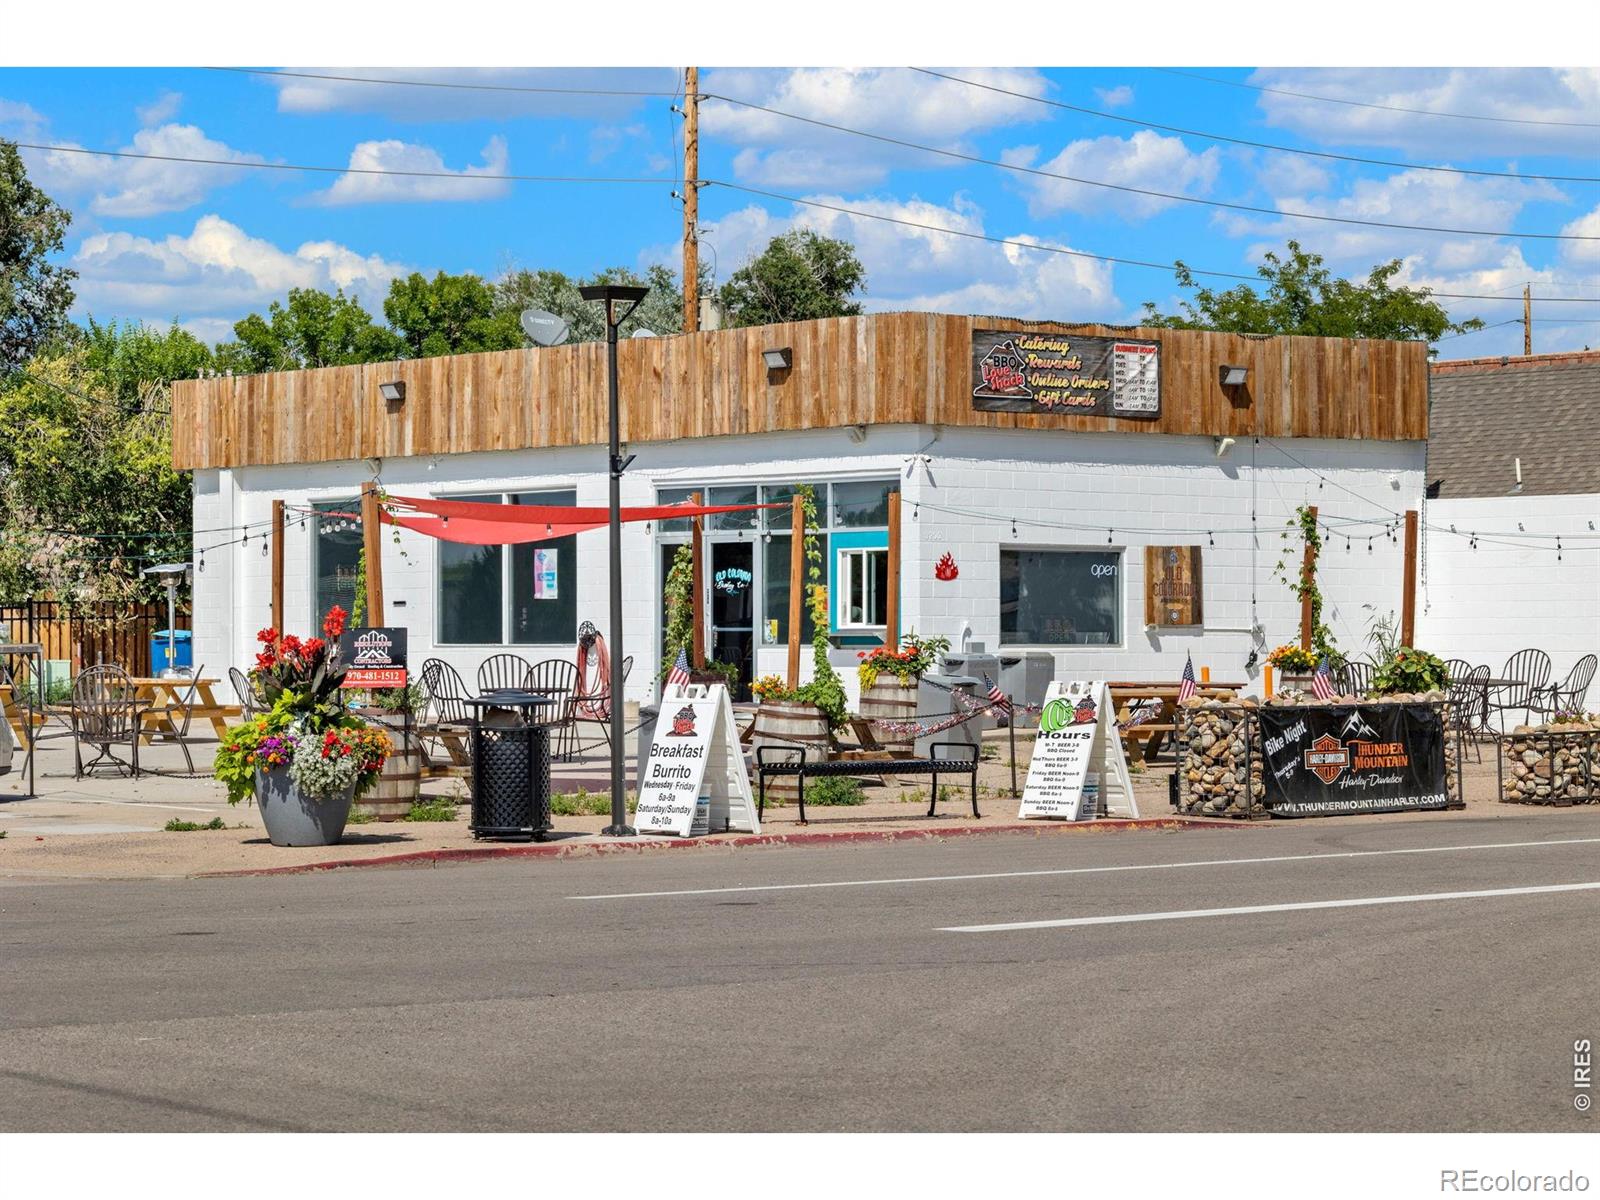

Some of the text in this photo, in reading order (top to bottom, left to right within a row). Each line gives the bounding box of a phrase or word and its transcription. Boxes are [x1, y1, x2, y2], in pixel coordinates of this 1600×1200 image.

[1019, 335, 1070, 356] Catering
[993, 355, 1017, 370] BBQ
[1028, 353, 1082, 370] Rewards
[1031, 372, 1069, 388] Online
[1071, 374, 1110, 390] Orders
[1038, 390, 1097, 410] Gift Cards
[1090, 564, 1117, 578] open
[346, 671, 400, 680] 970-481-1512
[1037, 730, 1091, 739] Hours
[1265, 719, 1307, 756] Bike Night
[650, 743, 704, 758] Breakfast
[1346, 740, 1405, 756] THUNDER
[652, 763, 692, 778] Burrito
[1352, 755, 1409, 773] MOUNTAIN
[644, 781, 696, 792] Wednesday Friday
[1338, 773, 1404, 790] Harley-Davidson
[638, 804, 692, 816] Saturday/Sunday
